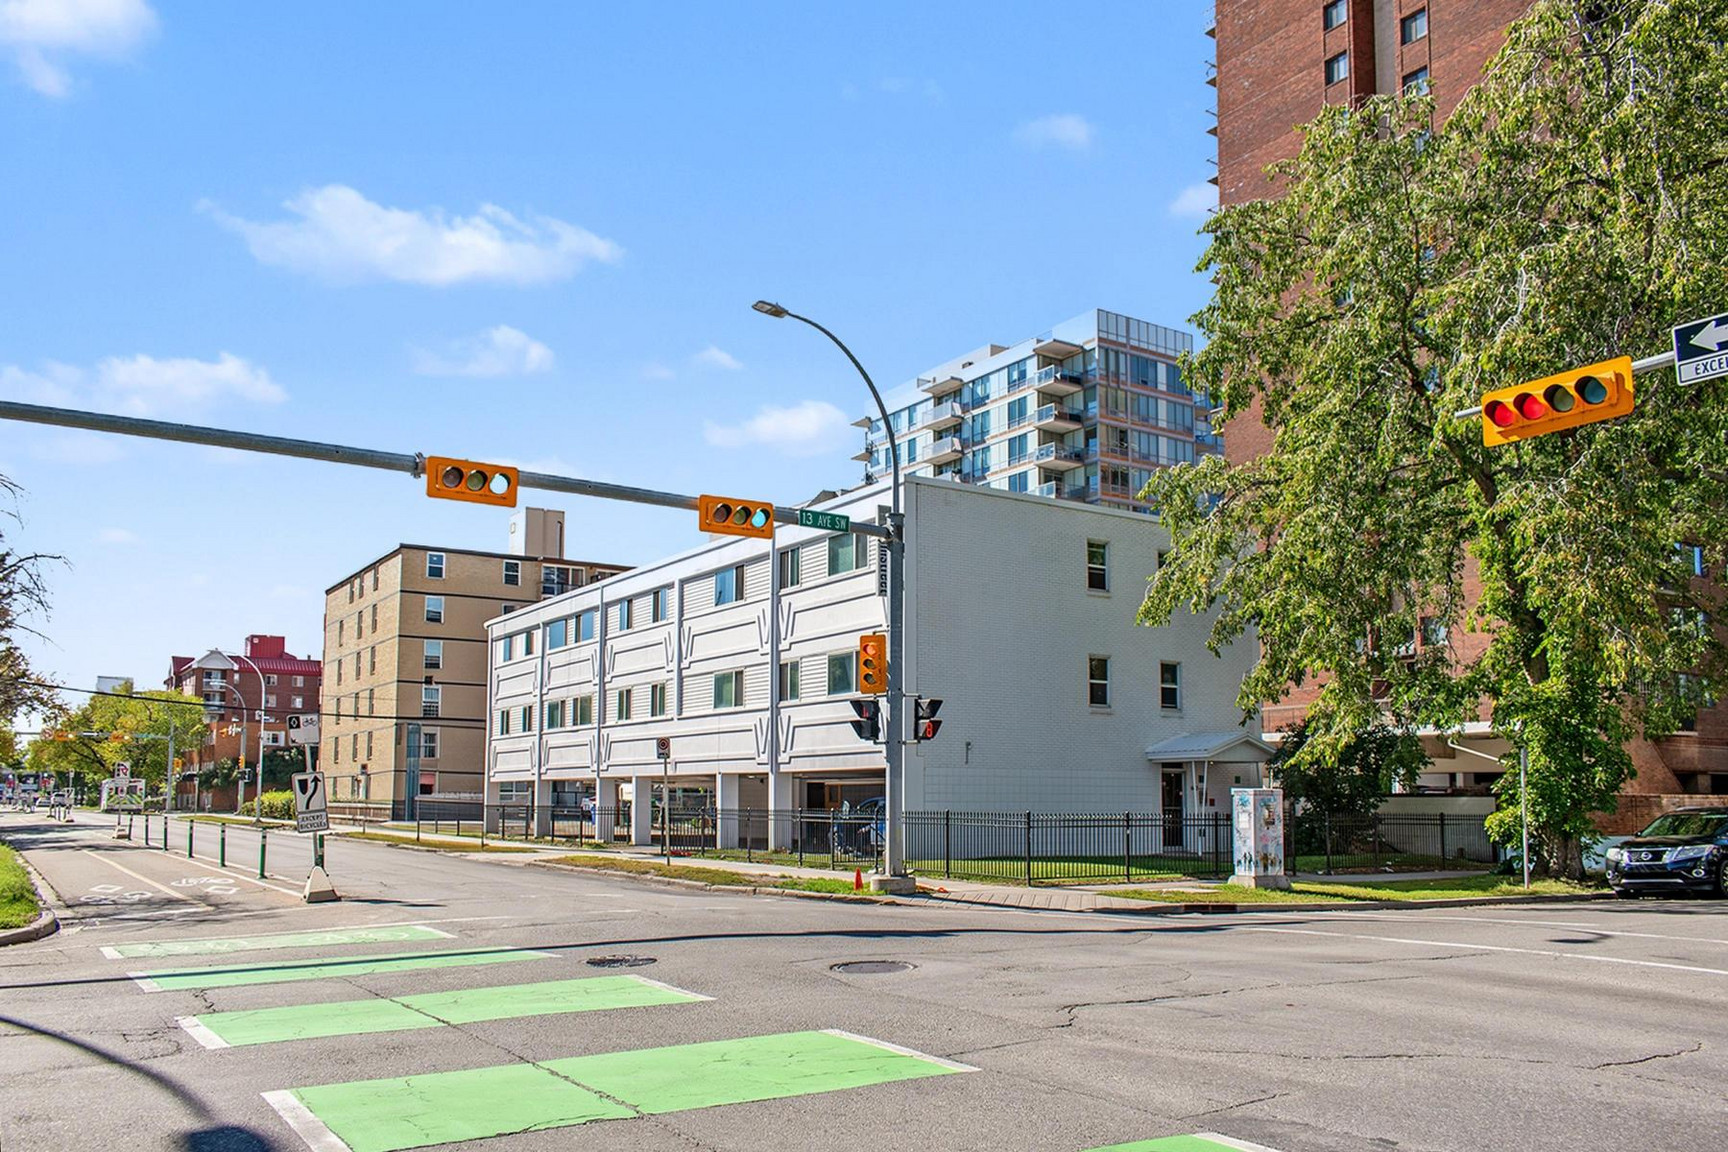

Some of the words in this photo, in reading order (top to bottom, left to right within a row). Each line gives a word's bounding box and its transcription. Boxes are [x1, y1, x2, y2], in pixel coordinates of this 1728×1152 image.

[802, 512, 813, 525] 13
[817, 514, 832, 528] AVE
[835, 517, 847, 530] SW
